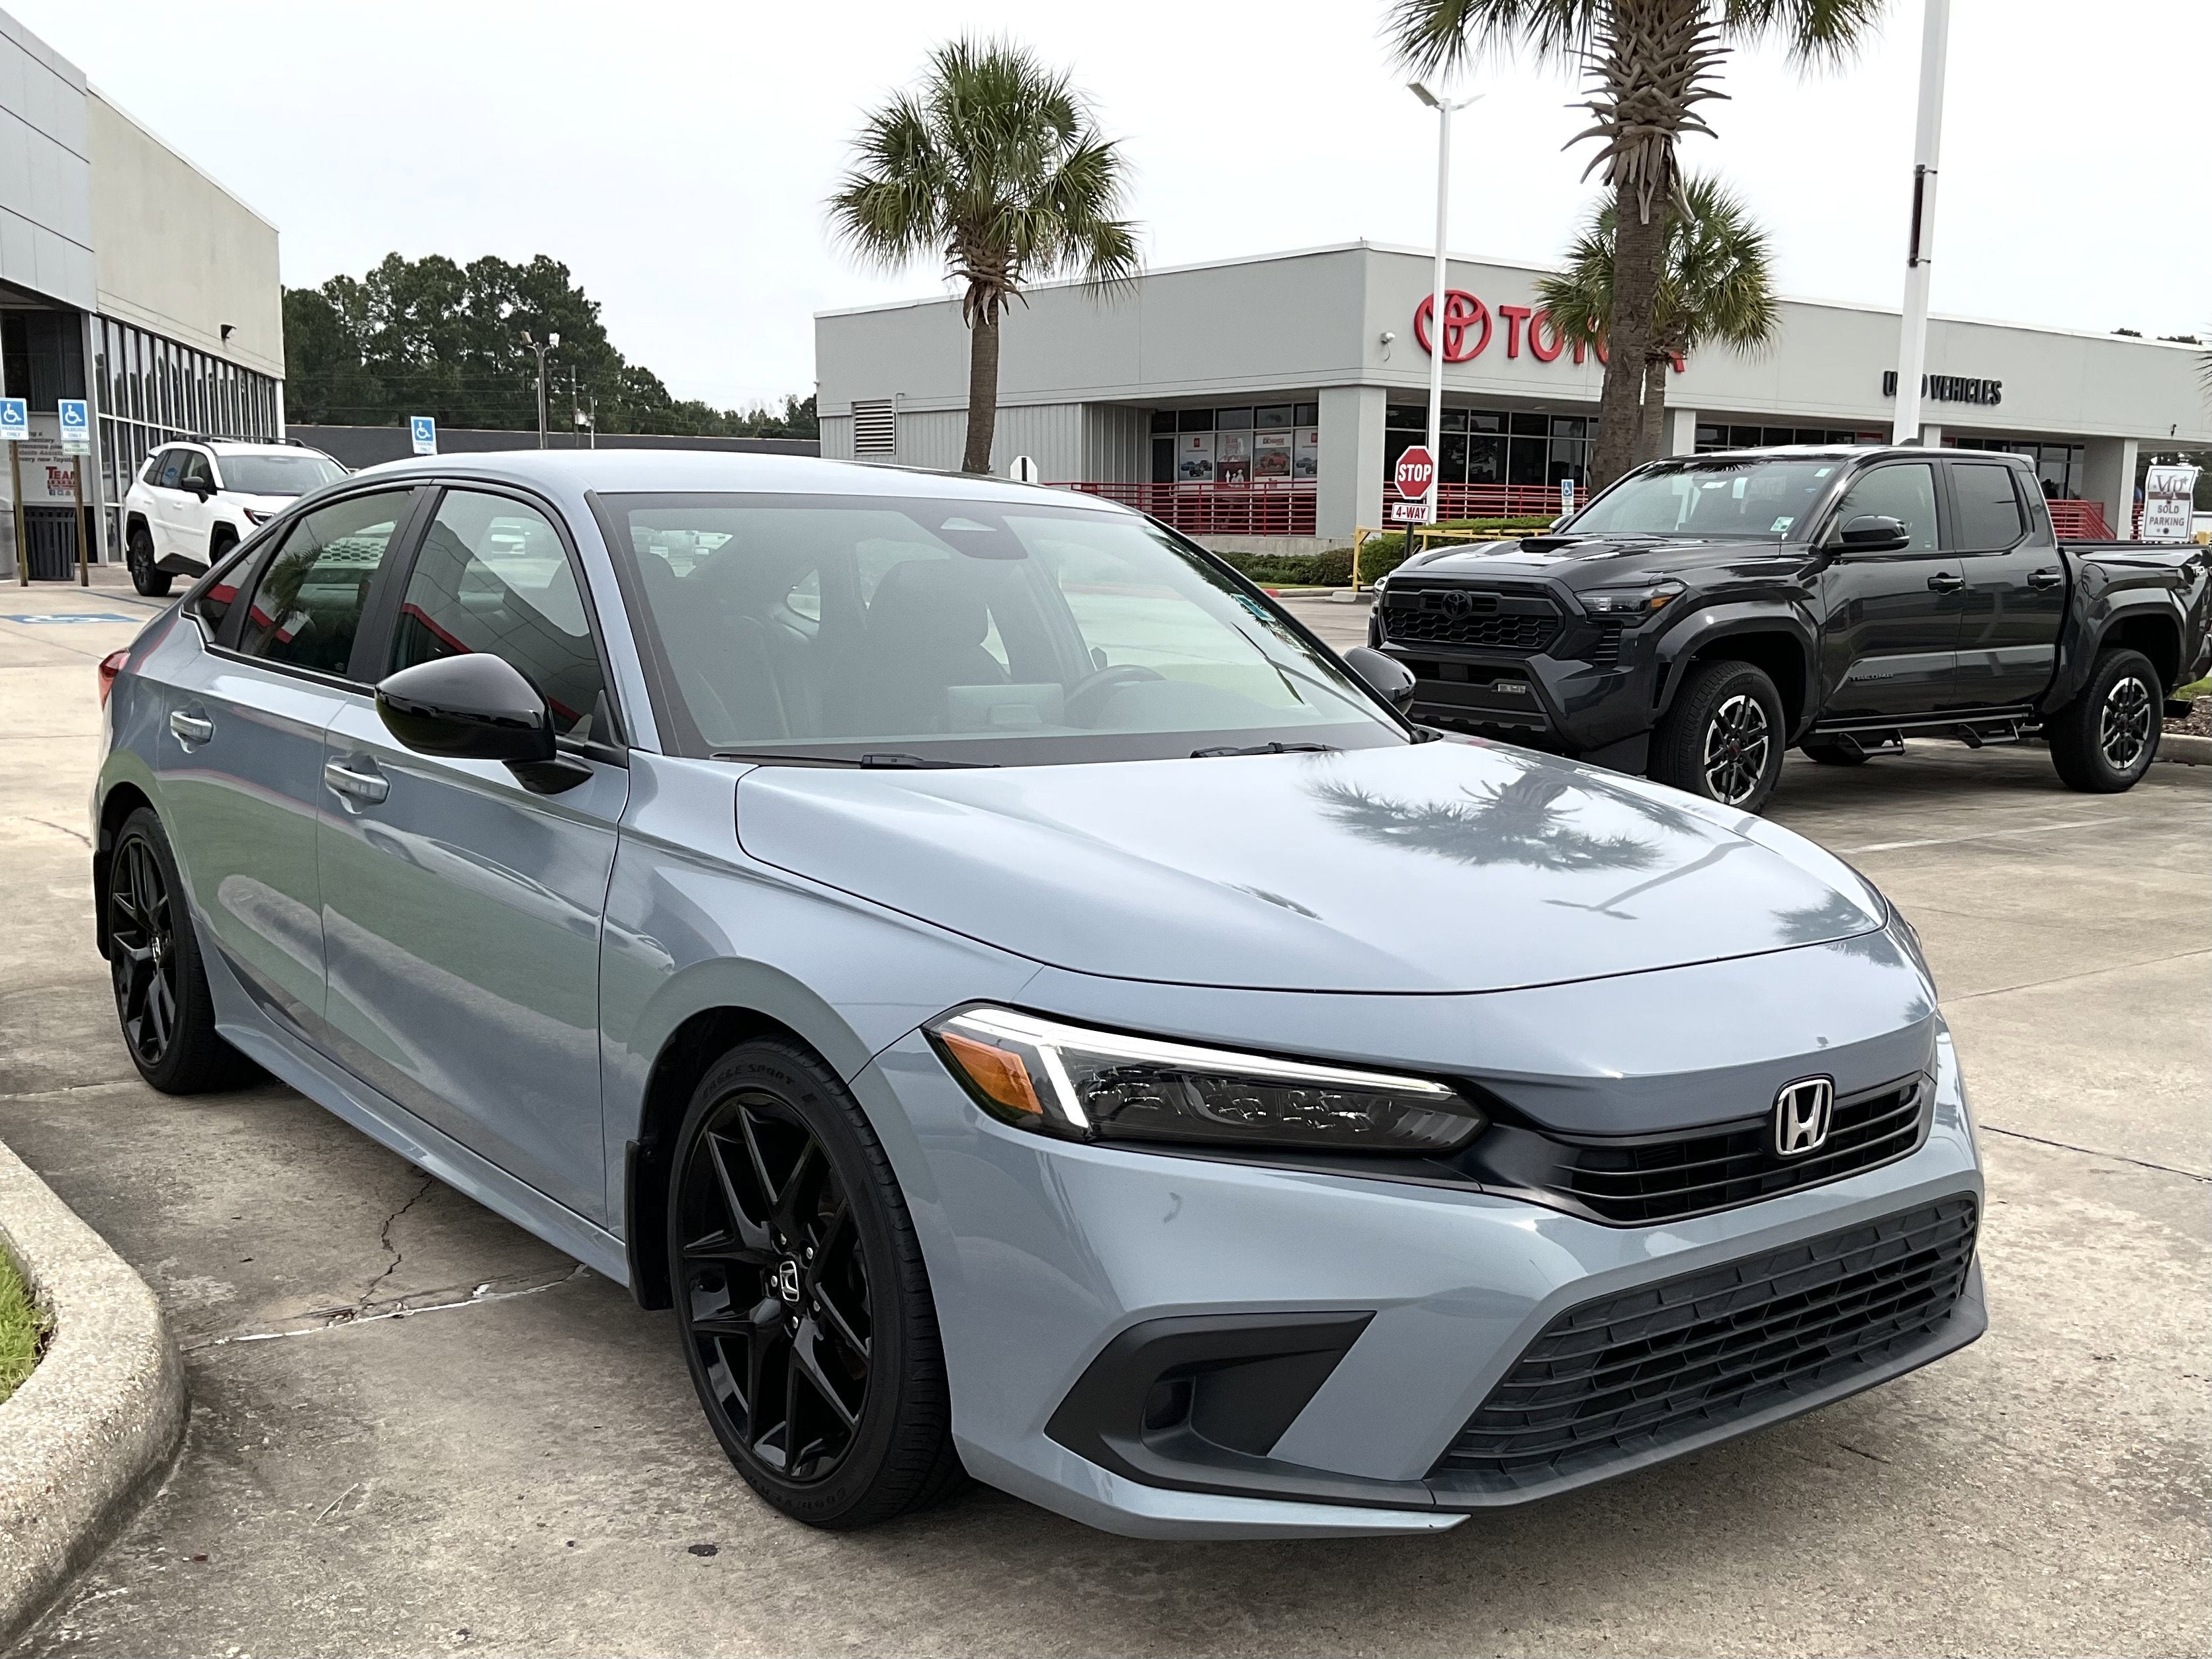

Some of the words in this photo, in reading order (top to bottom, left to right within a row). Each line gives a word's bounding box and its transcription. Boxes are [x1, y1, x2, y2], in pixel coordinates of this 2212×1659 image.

[1883, 371, 1928, 398] UD
[1929, 375, 2002, 406] VEHICLES
[1398, 464, 1432, 482] STOP
[1396, 506, 1426, 519] 4-WAY
[2157, 505, 2180, 514] SOLD
[2149, 517, 2185, 526] PARKING
